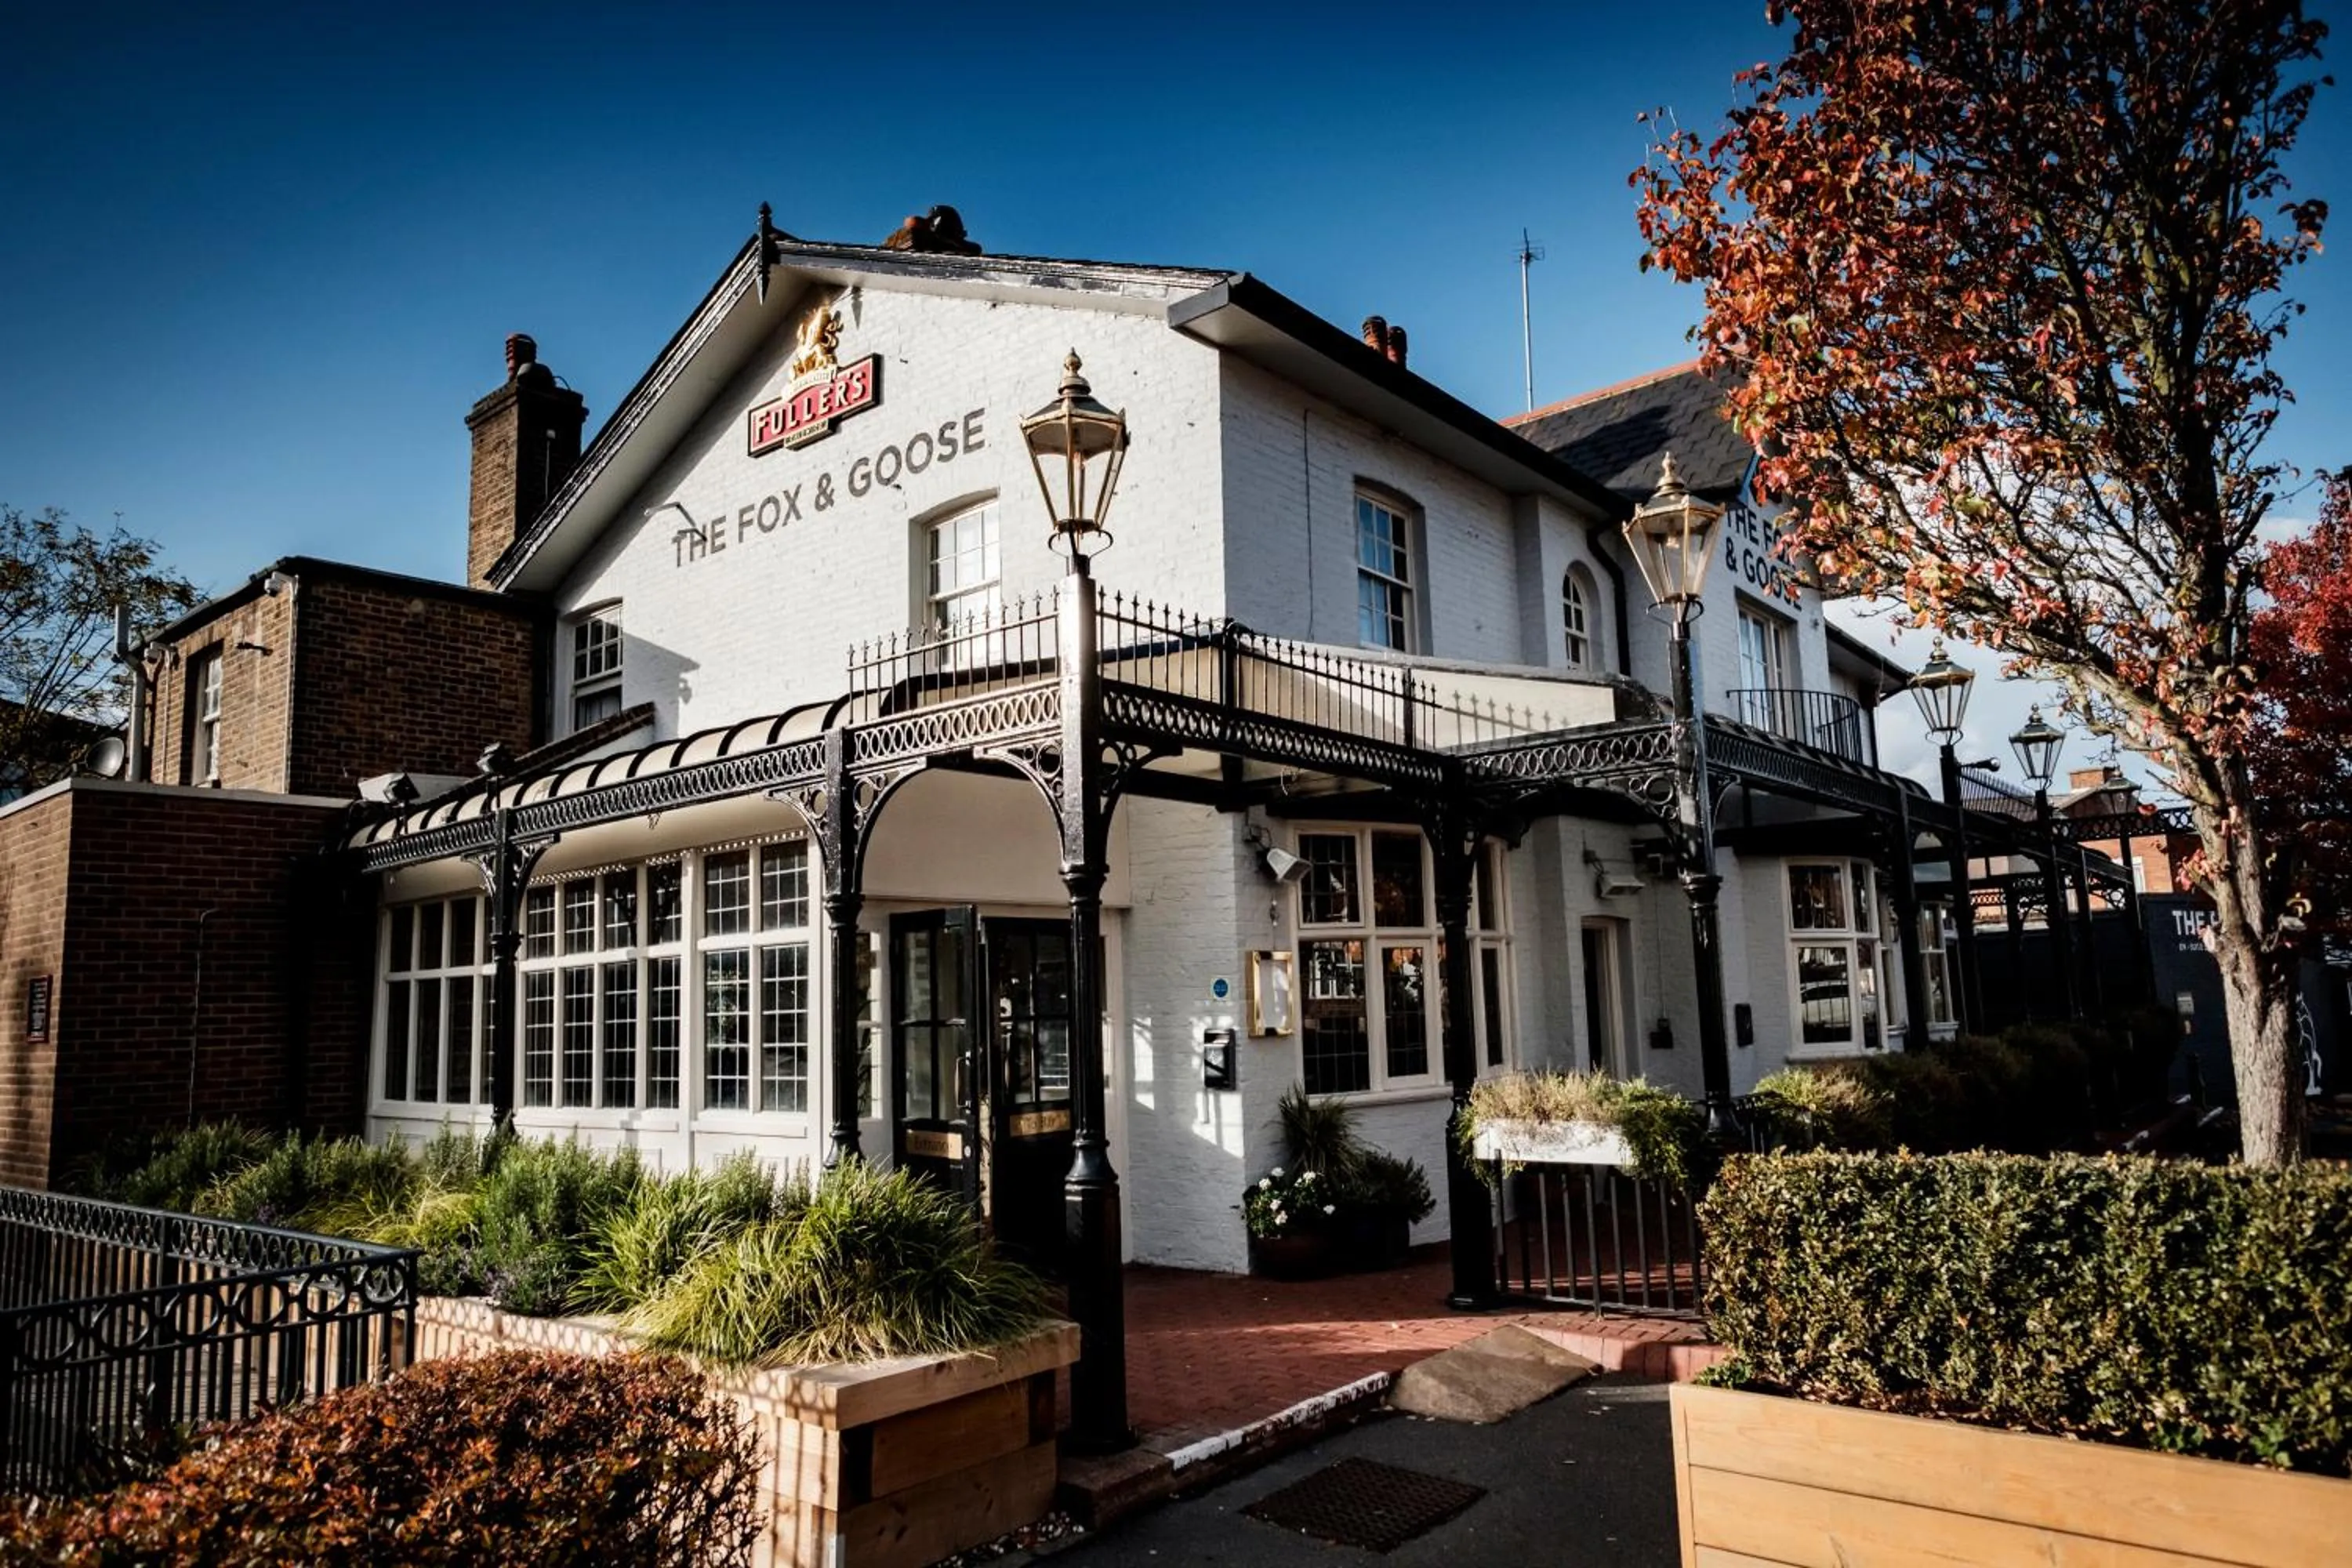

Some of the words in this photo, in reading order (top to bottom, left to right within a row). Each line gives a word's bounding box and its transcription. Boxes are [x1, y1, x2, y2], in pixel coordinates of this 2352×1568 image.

[755, 371, 866, 443] FULLER'S
[672, 515, 727, 568] THE
[738, 484, 803, 543] FOX
[815, 472, 836, 512] &
[848, 408, 985, 498] GOOSE
[1726, 536, 1737, 573] &
[1727, 508, 1759, 546] THE
[1763, 520, 1796, 571] FO
[2172, 909, 2205, 936] THE
